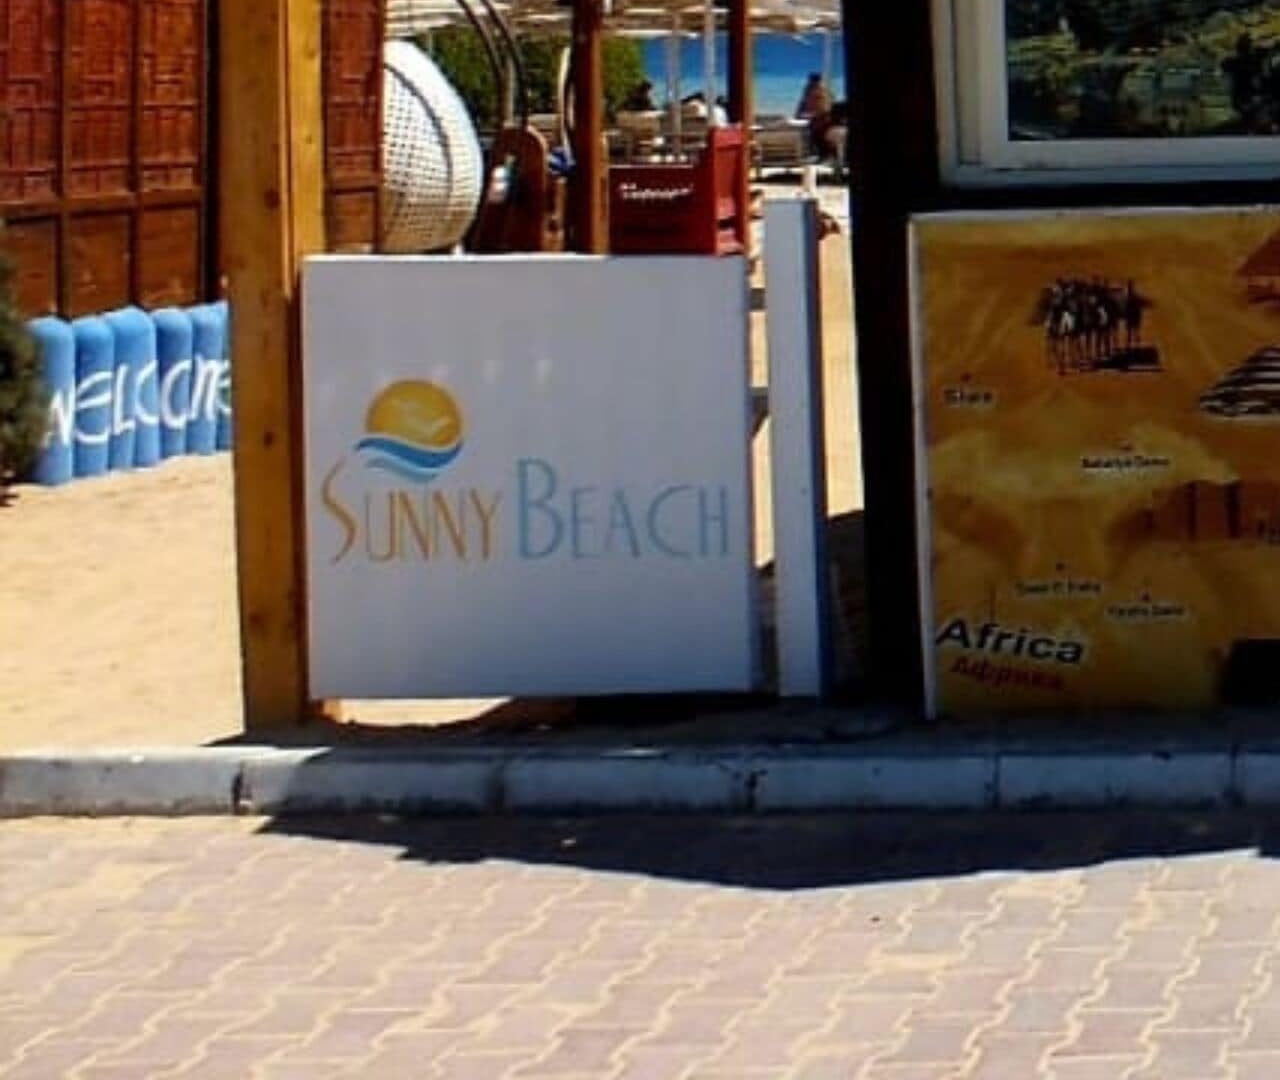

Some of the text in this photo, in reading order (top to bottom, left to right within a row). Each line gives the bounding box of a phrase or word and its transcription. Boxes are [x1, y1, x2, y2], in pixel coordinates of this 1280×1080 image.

[321, 456, 730, 564] SUNNY BEACH
[936, 619, 1084, 664] Africa
